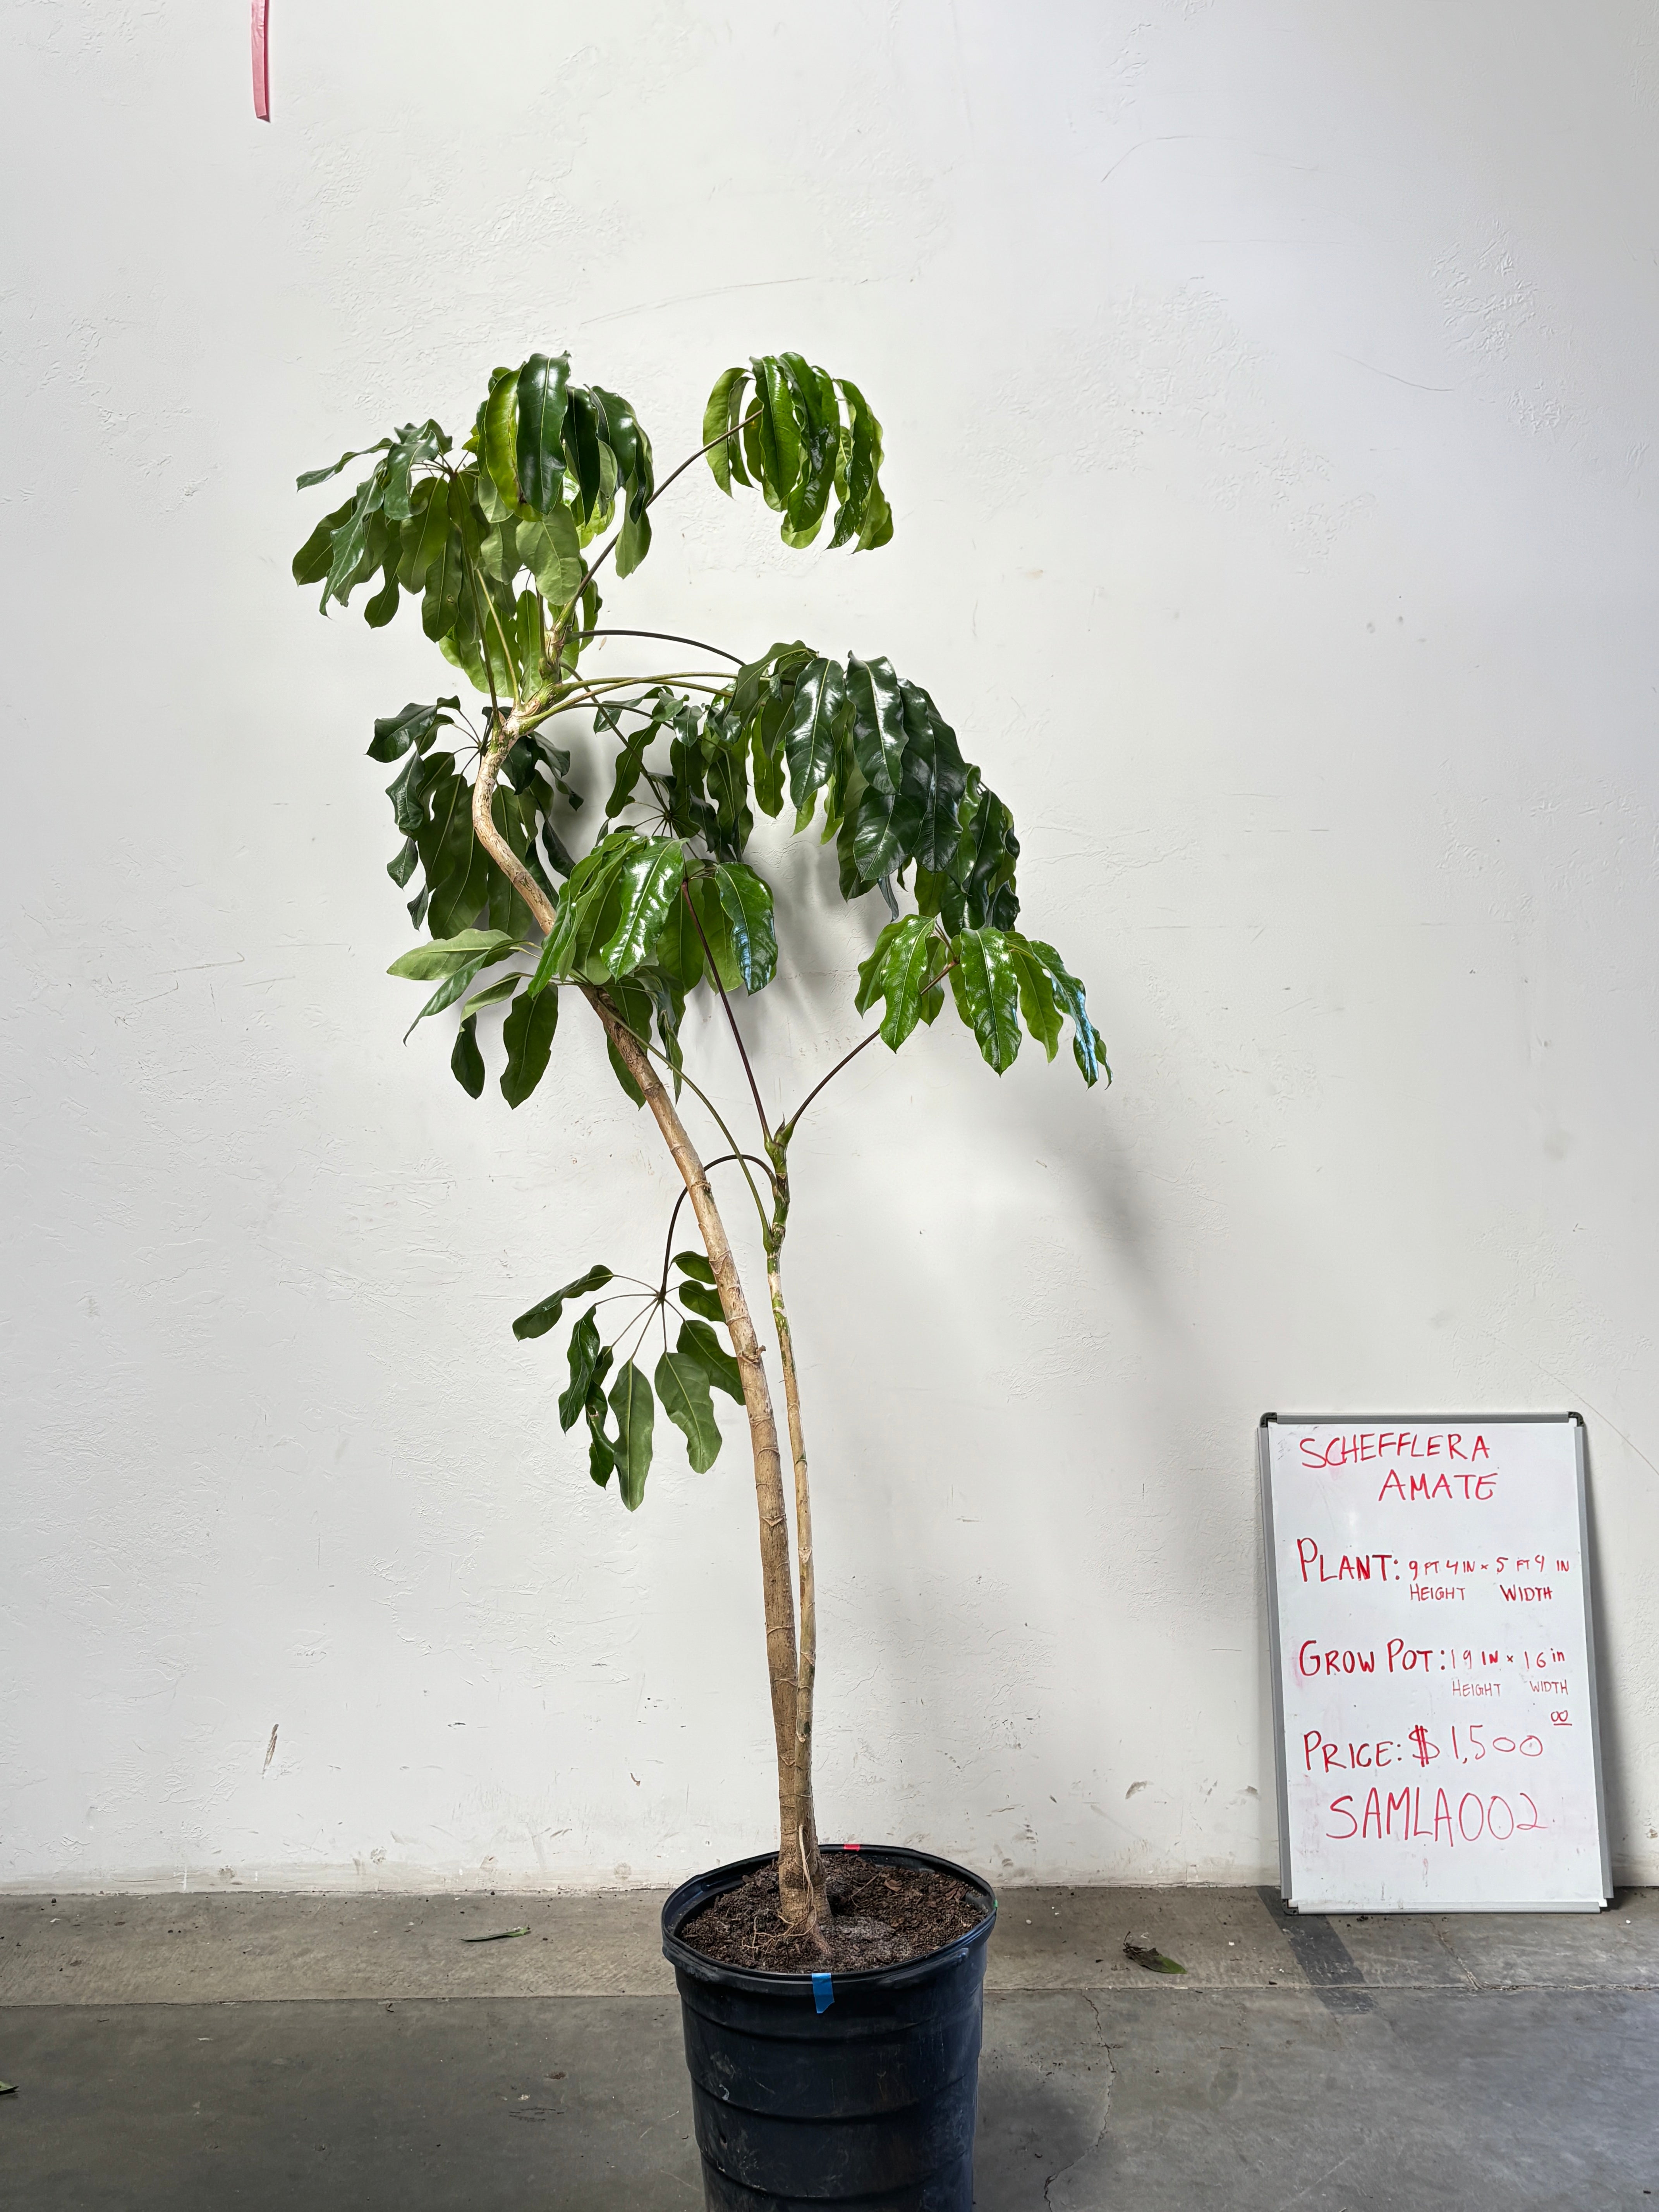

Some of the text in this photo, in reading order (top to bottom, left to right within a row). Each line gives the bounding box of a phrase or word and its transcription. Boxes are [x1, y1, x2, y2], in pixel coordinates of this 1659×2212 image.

[1300, 1432, 1490, 1469] SCHEFFLERA
[1378, 1469, 1498, 1501] AMATE
[1297, 1537, 1401, 1582] PLANT:
[1409, 1561, 1418, 1580] 9
[1424, 1561, 1439, 1575] FT
[1446, 1560, 1458, 1575] 4
[1463, 1561, 1475, 1573] IN
[1496, 1557, 1509, 1573] 5
[1516, 1559, 1530, 1571] FT
[1556, 1560, 1570, 1572] IN
[1410, 1583, 1553, 1602] HEIGHT WIDTH
[1299, 1640, 1375, 1676] GROW
[1386, 1638, 1445, 1673] POT:
[1482, 1650, 1499, 1665] IN
[1524, 1651, 1546, 1668] 16
[1550, 1648, 1565, 1662] in
[1452, 1679, 1568, 1697] HEIGHT WIDTH
[1304, 1730, 1403, 1773] PRICE:
[1326, 1786, 1549, 1847] SAMLA002
